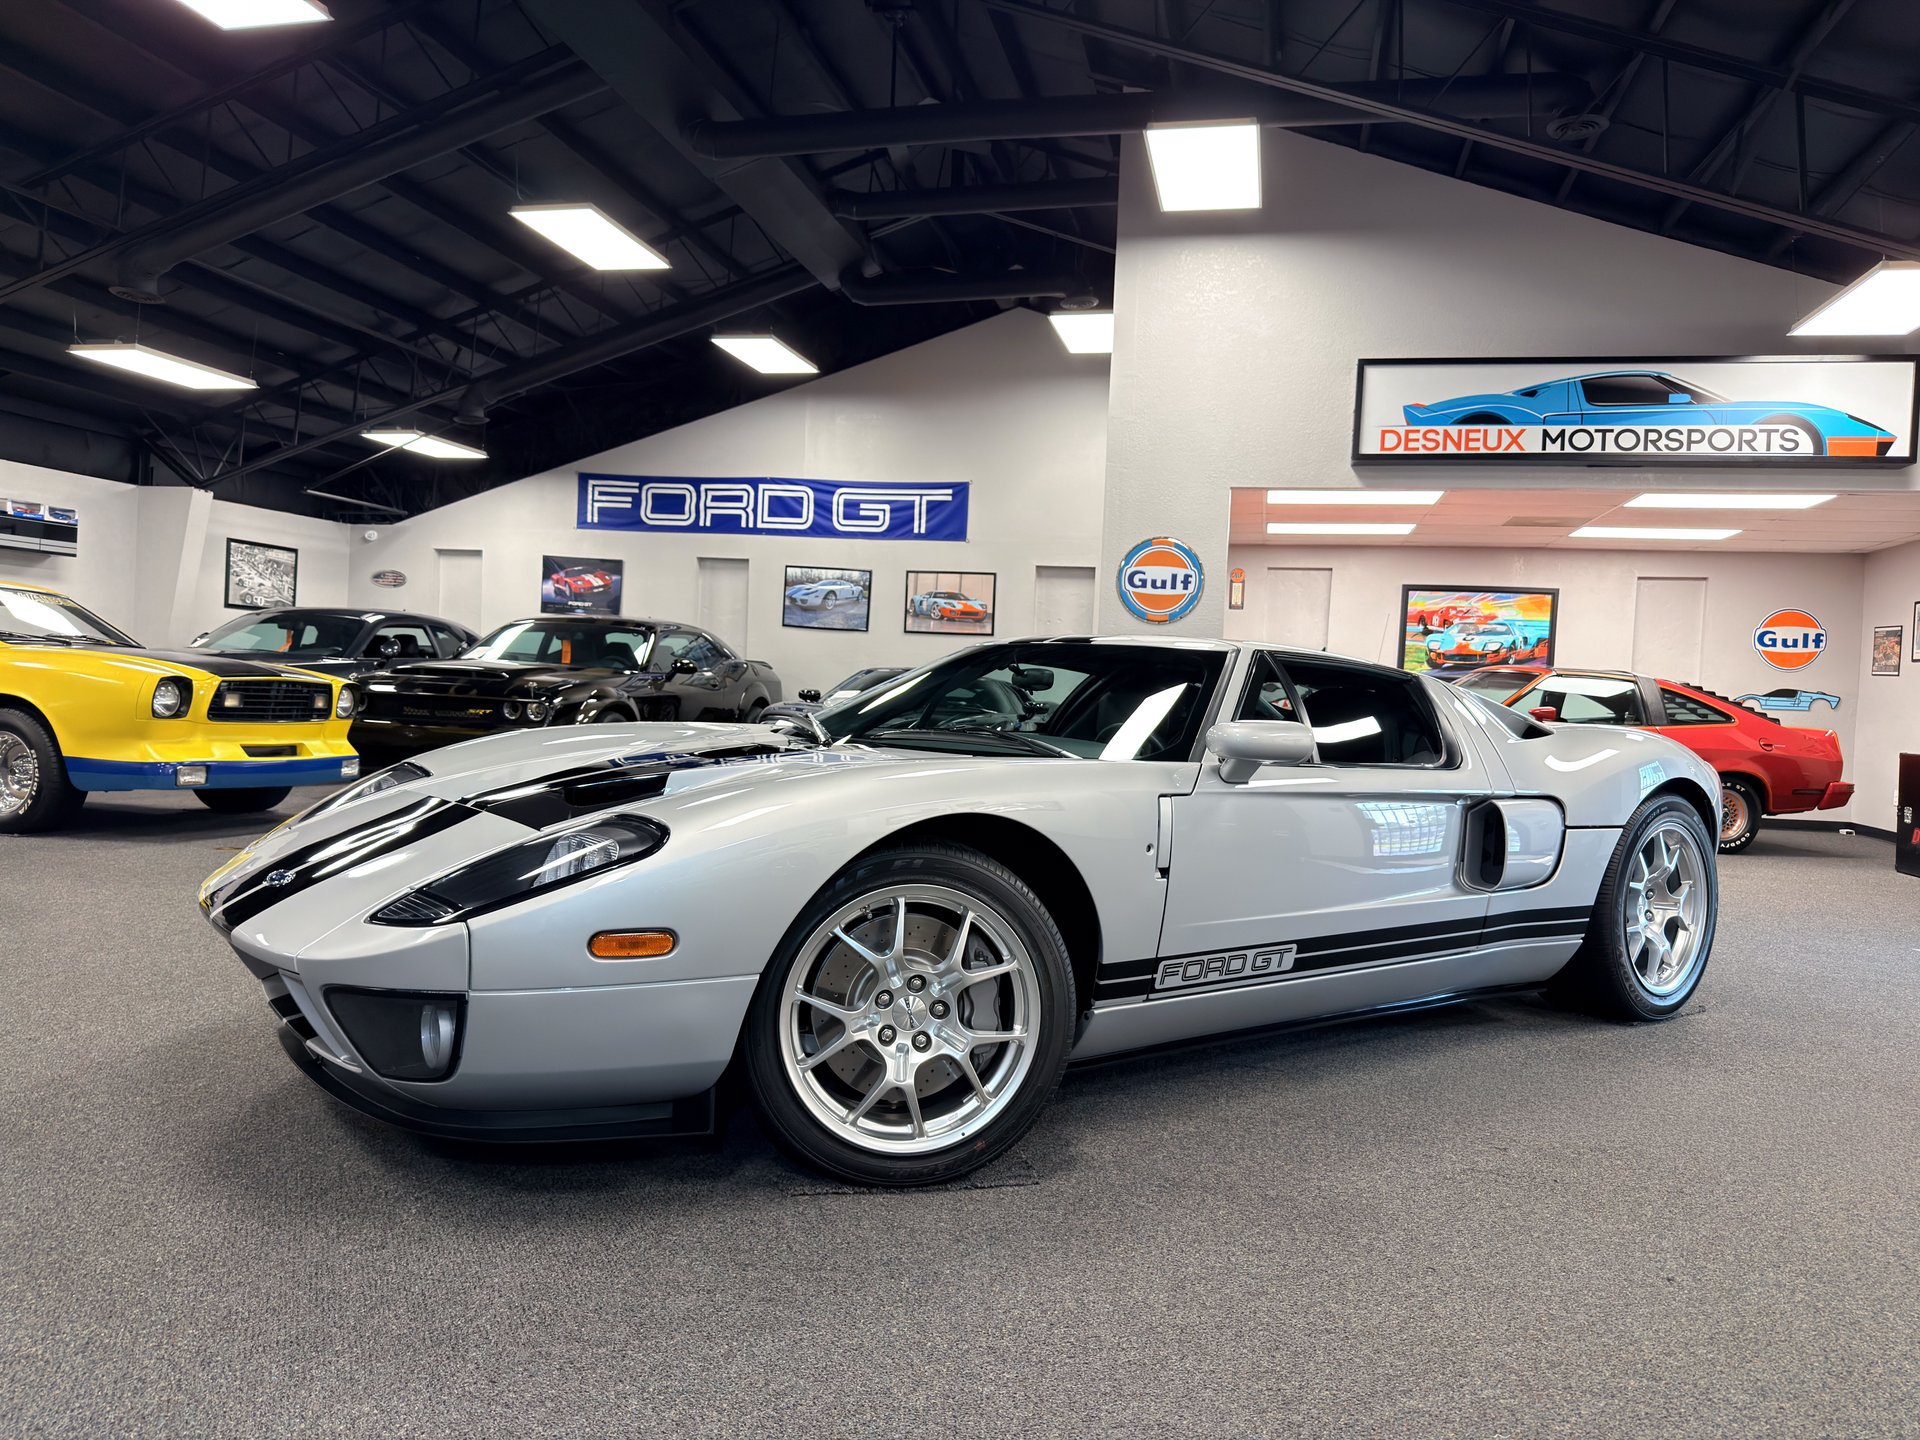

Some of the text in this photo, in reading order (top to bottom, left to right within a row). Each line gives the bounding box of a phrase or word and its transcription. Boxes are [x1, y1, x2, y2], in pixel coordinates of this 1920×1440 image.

[1379, 428, 1800, 453] DESNEUX MOTORSPORTS
[587, 479, 953, 534] FORD GT
[1127, 569, 1193, 591] Gulf
[1757, 630, 1825, 649] Gulf
[1159, 947, 1294, 986] FORD GT
